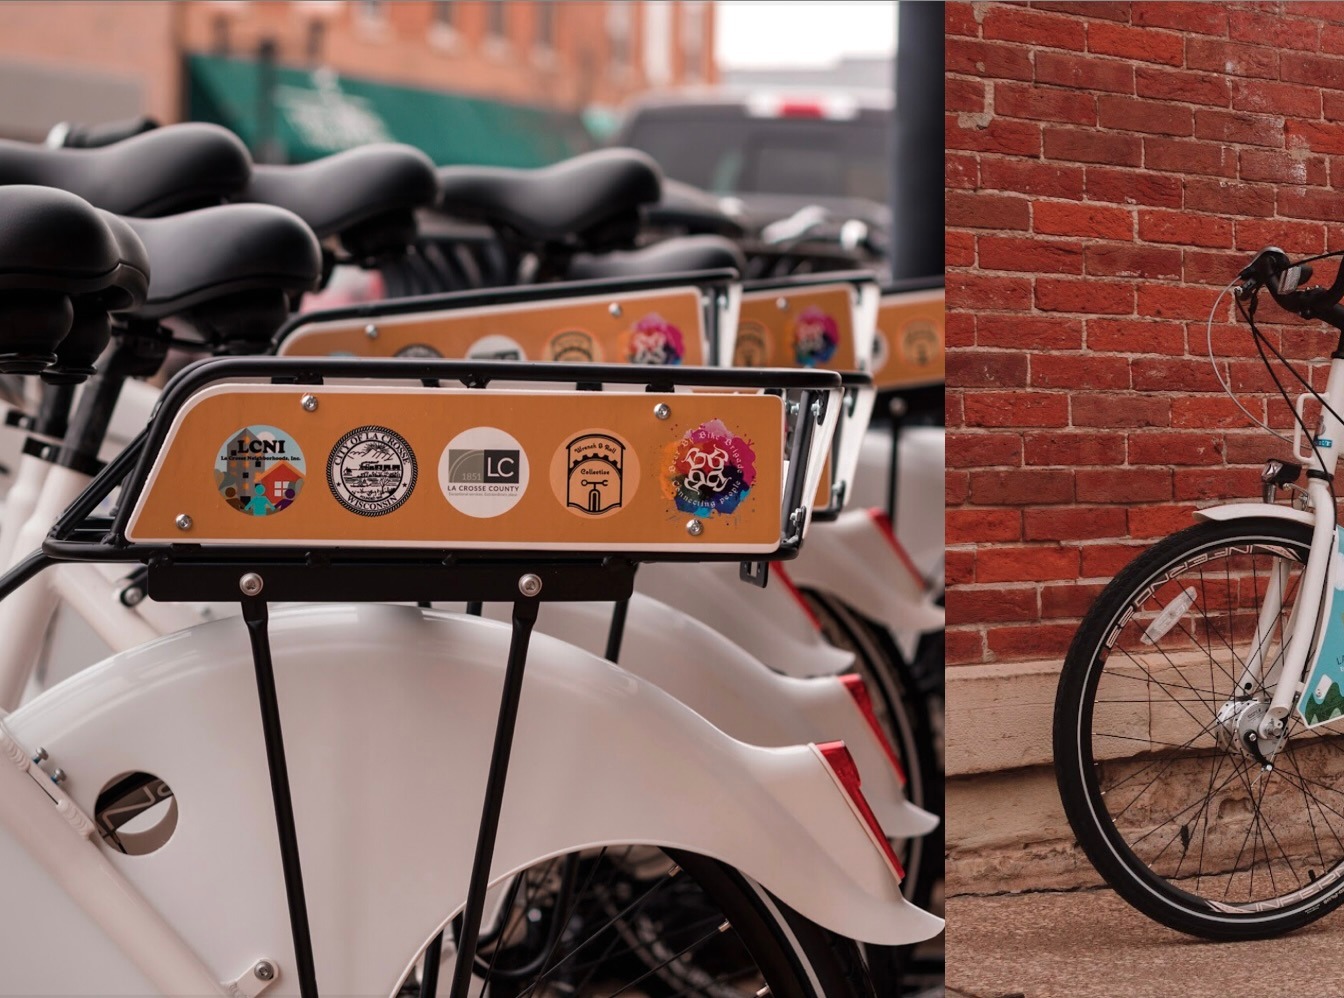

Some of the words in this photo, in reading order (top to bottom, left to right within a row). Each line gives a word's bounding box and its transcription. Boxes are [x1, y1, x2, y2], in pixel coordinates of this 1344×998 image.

[238, 440, 286, 454] LCNI
[334, 443, 350, 466] CITY
[350, 432, 362, 444] OF
[382, 434, 410, 465] CROSSE
[487, 457, 514, 477] LC
[347, 495, 397, 510] WISCONSIN
